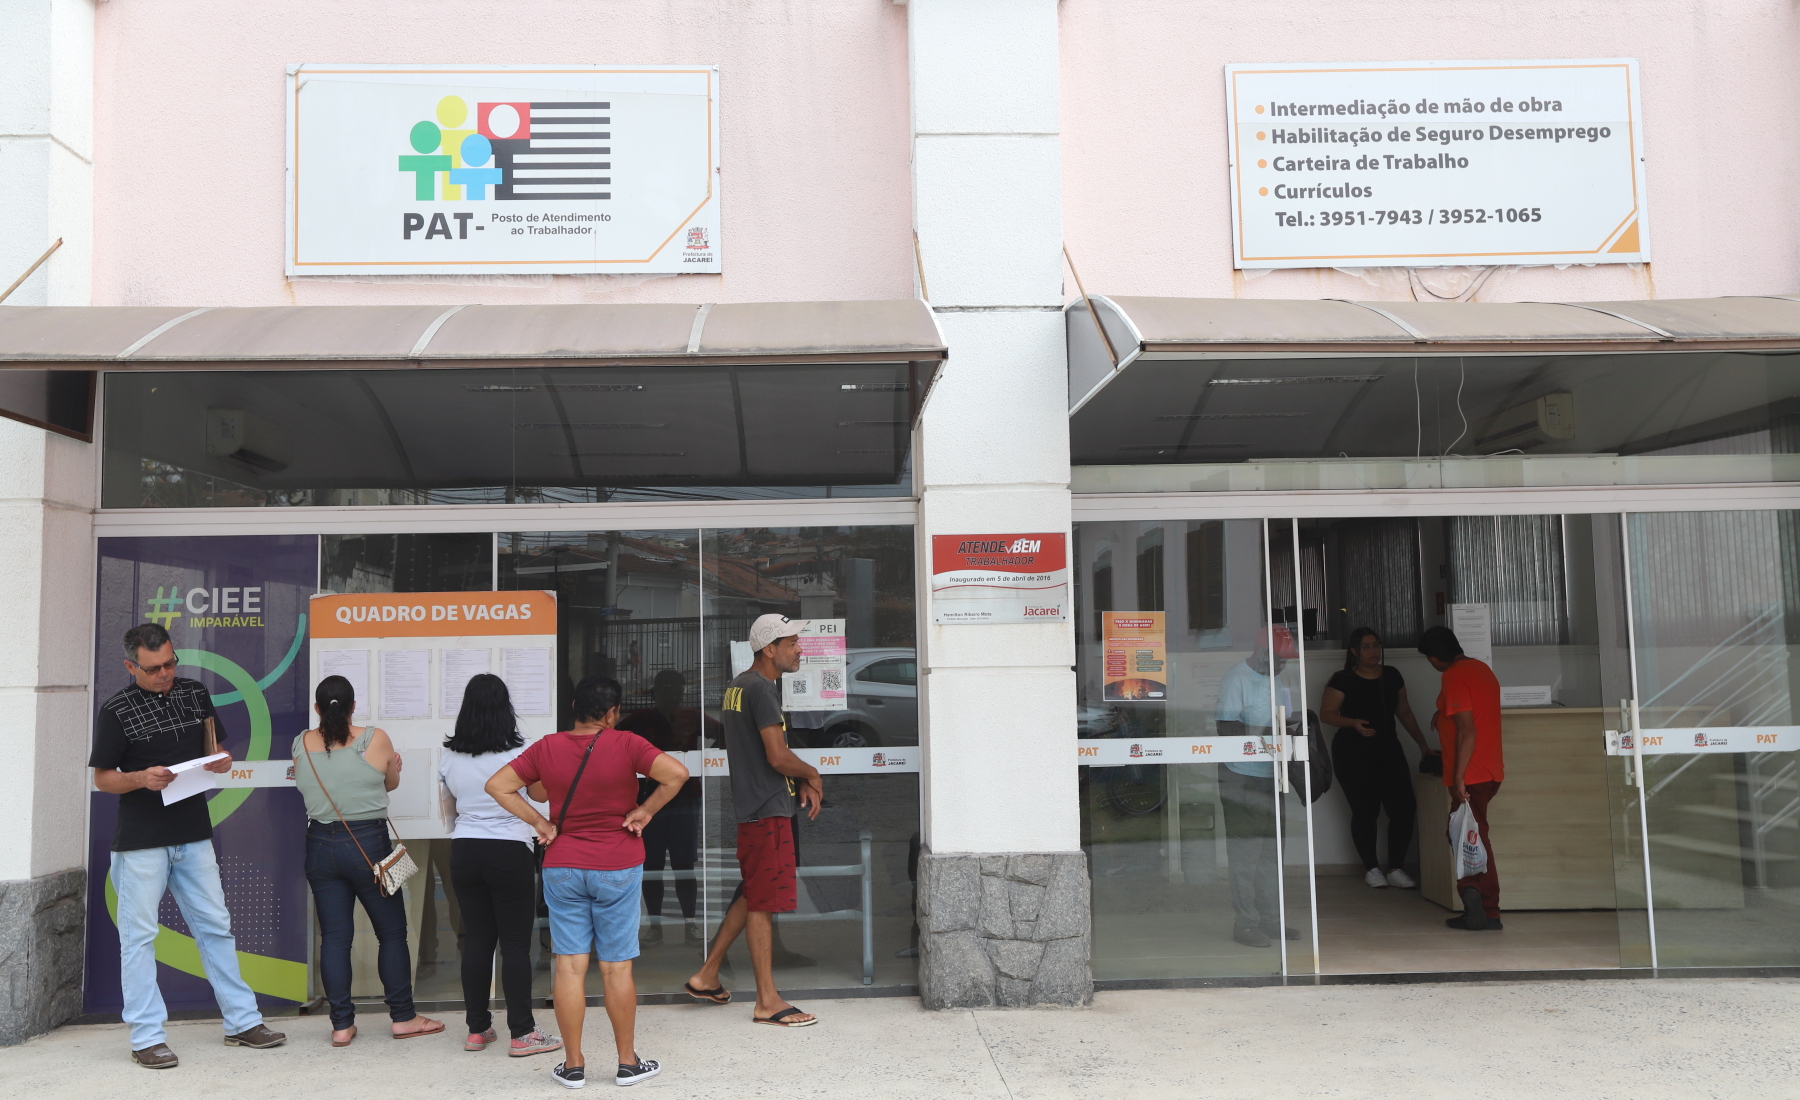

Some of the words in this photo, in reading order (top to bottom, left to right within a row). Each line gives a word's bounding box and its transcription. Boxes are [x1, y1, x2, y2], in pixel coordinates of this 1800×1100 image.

[1270, 98, 1411, 119] Intermediação
[1415, 98, 1439, 115] de
[1444, 98, 1485, 115] mão
[1490, 97, 1514, 114] de
[1518, 96, 1563, 113] obra
[1272, 127, 1383, 148] Habilitação
[1387, 126, 1411, 143] de
[1415, 126, 1484, 147] Seguro
[1489, 124, 1612, 143] Desemprego
[1272, 156, 1351, 172] Carteira
[1355, 155, 1380, 171] de
[1383, 153, 1470, 170] Trabalho
[1274, 182, 1373, 200] Currículos
[491, 213, 524, 223] Posto
[526, 213, 540, 222] de
[542, 212, 612, 223] Atendimento
[1275, 211, 1316, 227] Tel.:
[1319, 209, 1423, 227] 3951-7943
[1428, 208, 1435, 226] /
[1439, 207, 1543, 225] 3952-1065
[510, 227, 525, 236] ao
[527, 225, 593, 236] Trabalhador
[957, 541, 1006, 554] ATENDE
[1012, 539, 1042, 554] BEM
[965, 556, 1035, 567] TRABALHADOR
[949, 576, 985, 584] Inaugurado
[335, 605, 427, 624] QUADRO
[432, 605, 458, 621] DE
[462, 603, 532, 621] VAGAS
[1023, 604, 1061, 617] Jacareí
[190, 615, 265, 628] IMPARÁVEL
[819, 624, 837, 634] PEI
[1643, 736, 1664, 746] PAT
[1757, 734, 1778, 744] PAT
[1078, 747, 1099, 757] PAT
[1191, 745, 1213, 755] PAT
[704, 758, 726, 768] PAT
[819, 756, 842, 766] PAT
[231, 769, 254, 779] PAT
